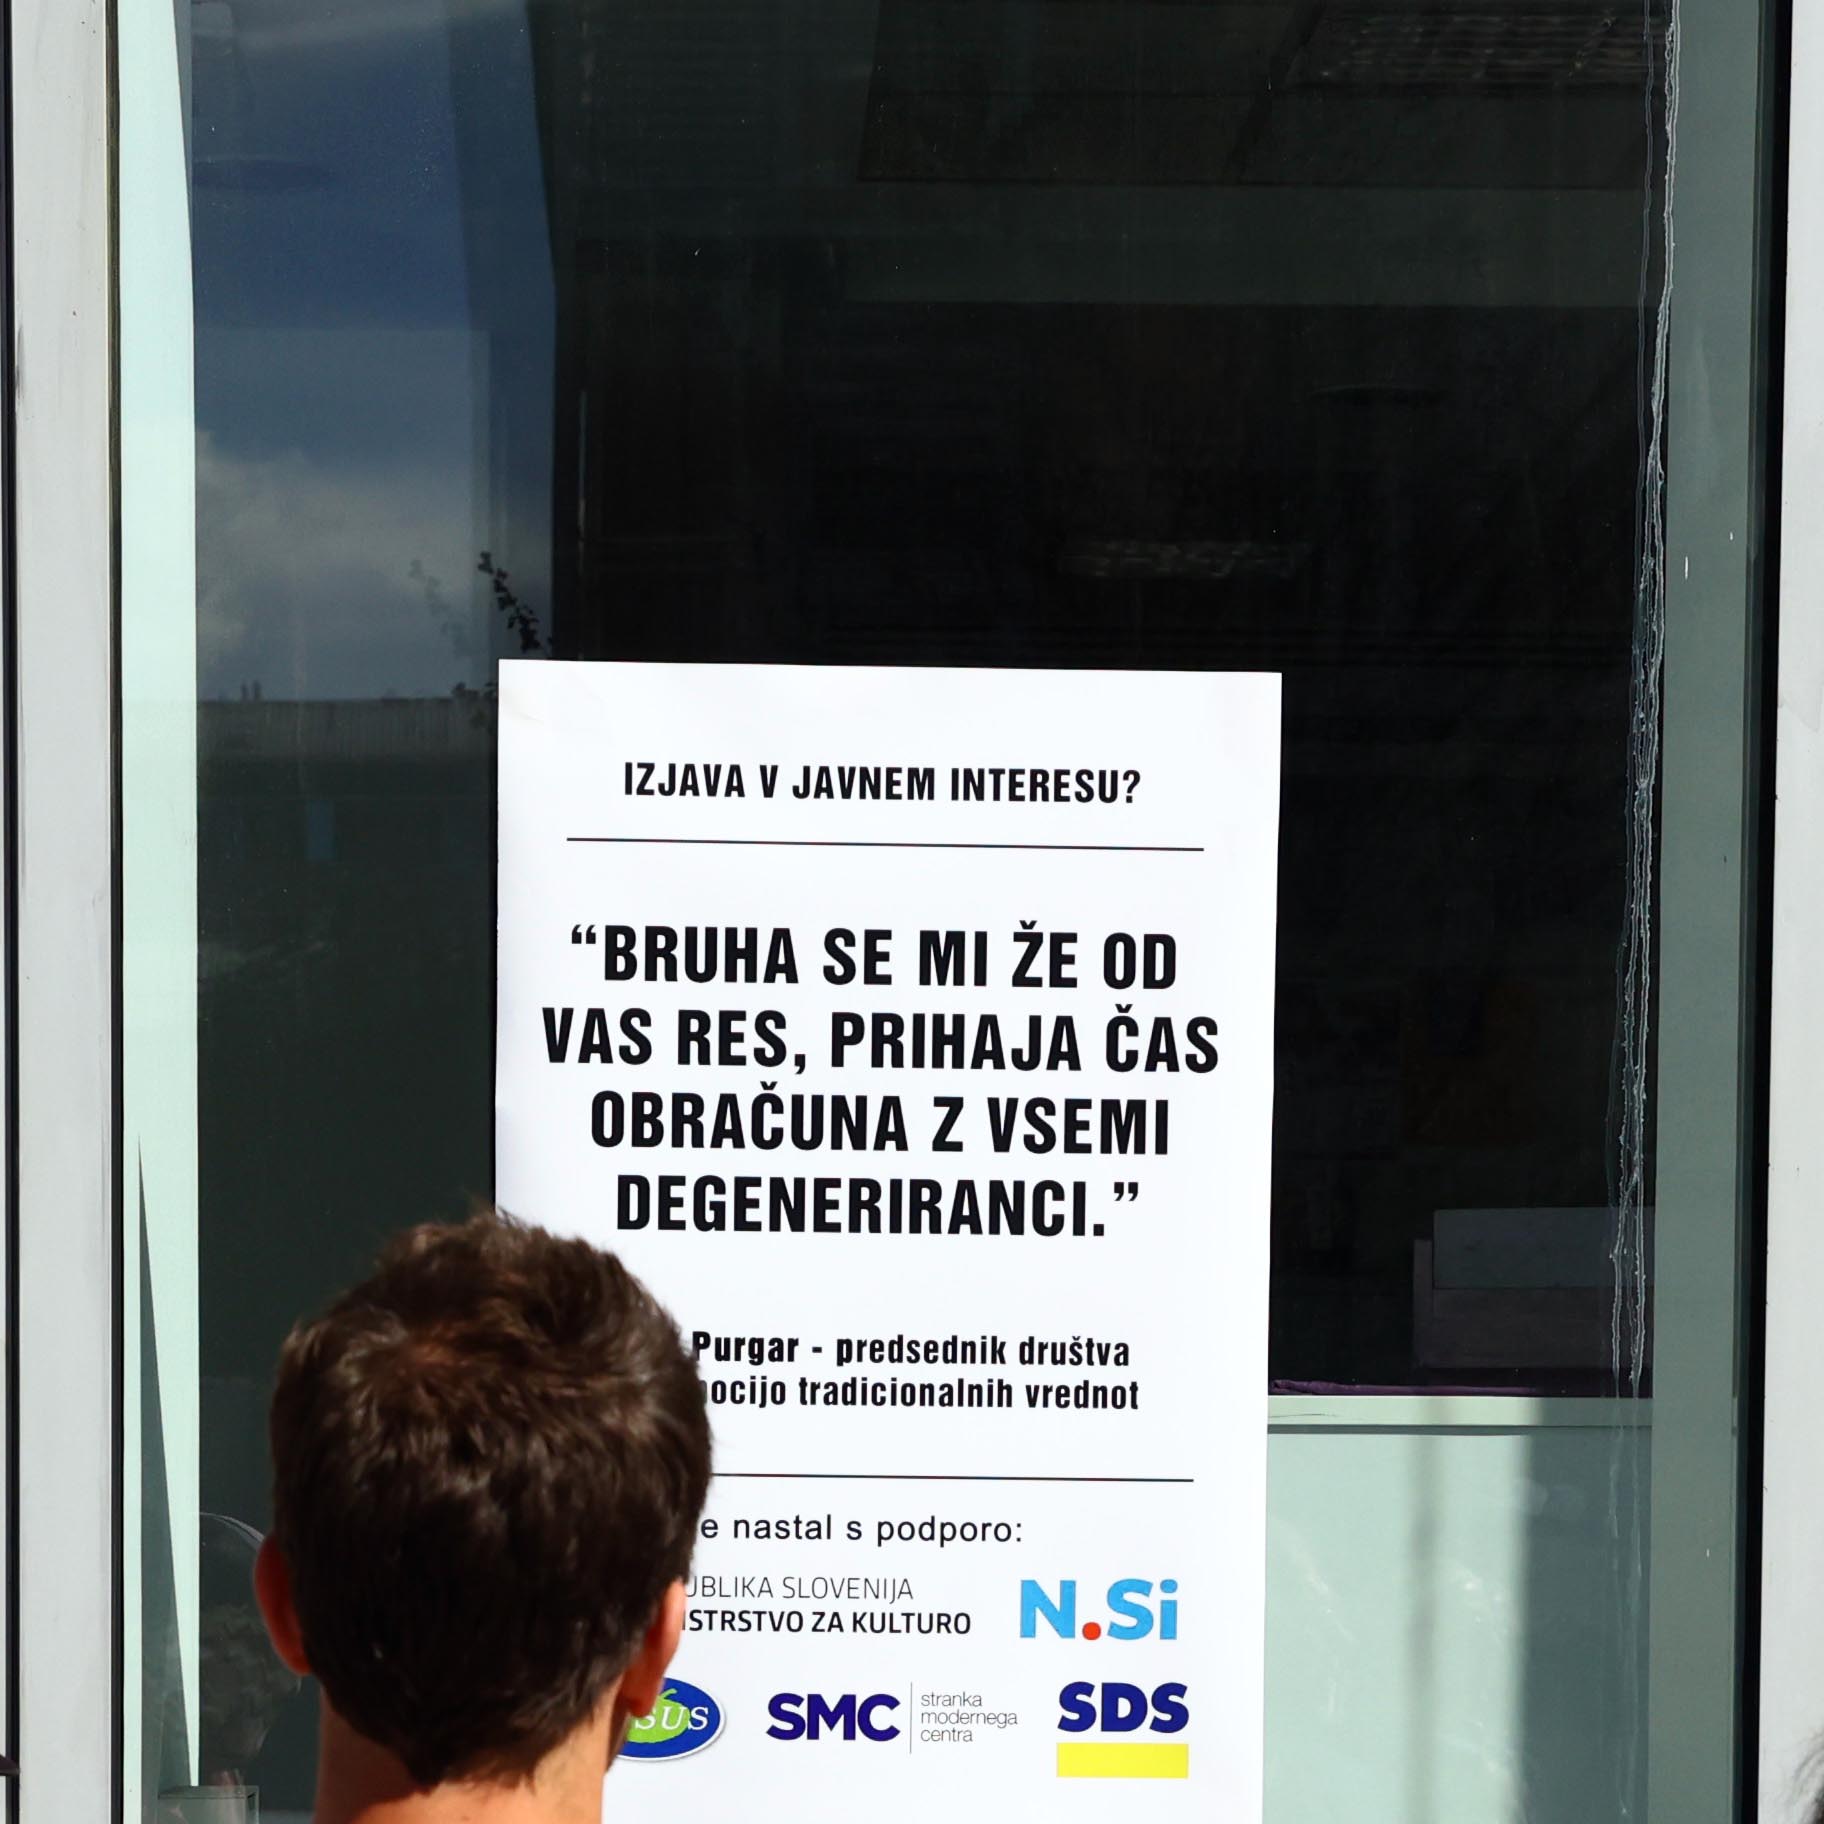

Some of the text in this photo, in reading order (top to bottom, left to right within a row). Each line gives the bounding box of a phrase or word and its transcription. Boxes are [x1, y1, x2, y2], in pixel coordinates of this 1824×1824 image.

[624, 761, 1141, 804] IZJAVA V JAVNEM INTERESU?
[822, 927, 893, 986] SE
[918, 929, 988, 988] MI
[1011, 919, 1078, 989] ŽE
[1103, 931, 1177, 991] OD
[541, 1003, 1219, 1076] VAS RES, PRIHAJA ČAS
[591, 1080, 1169, 1156] OBRAČUNA Z VSEMI
[693, 1331, 800, 1366] Purgar
[836, 1333, 1007, 1368] predsednik
[1018, 1335, 1130, 1367] društva
[702, 1376, 1139, 1411] ocijo tradicionalnih vrednot
[700, 1513, 1022, 1549] e nastal s podporo:
[782, 1576, 914, 1605] SLOVENIJA
[811, 1611, 845, 1633] ZA
[852, 1611, 971, 1635] KULTURO
[765, 1692, 902, 1743] SMC
[920, 1691, 983, 1708] stranka
[1056, 1680, 1190, 1734] SDS
[920, 1727, 973, 1743] centra
[921, 1709, 1018, 1729] modernega
